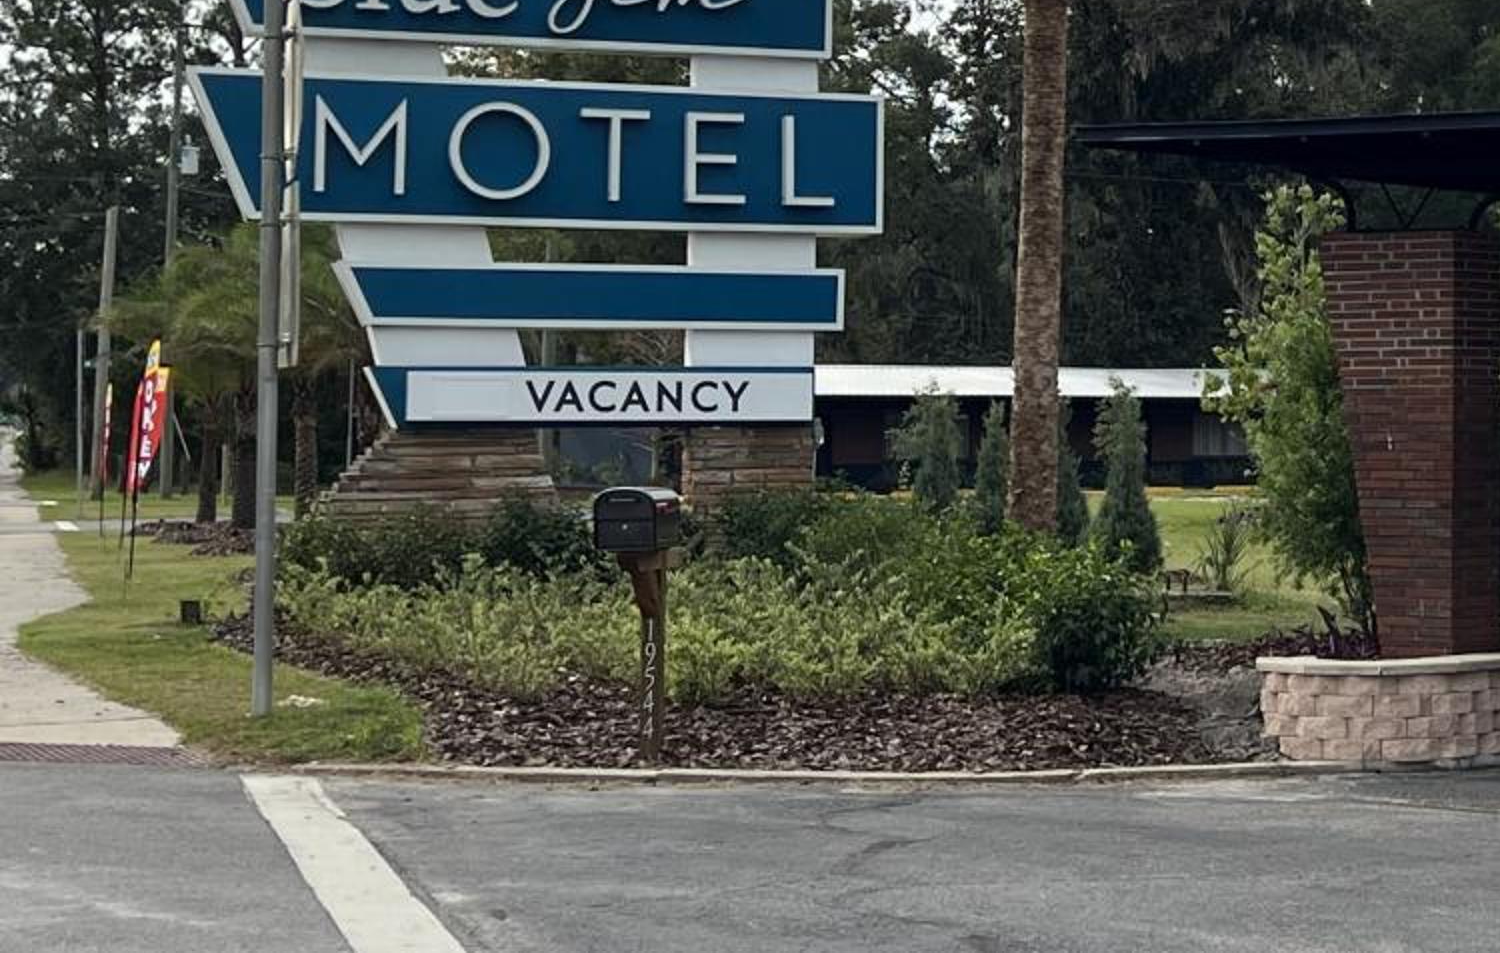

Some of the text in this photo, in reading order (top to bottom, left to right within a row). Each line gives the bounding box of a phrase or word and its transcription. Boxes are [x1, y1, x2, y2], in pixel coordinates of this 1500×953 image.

[314, 94, 835, 208] MOTEL
[525, 380, 749, 413] VACANCY
[642, 617, 657, 739] 19544
